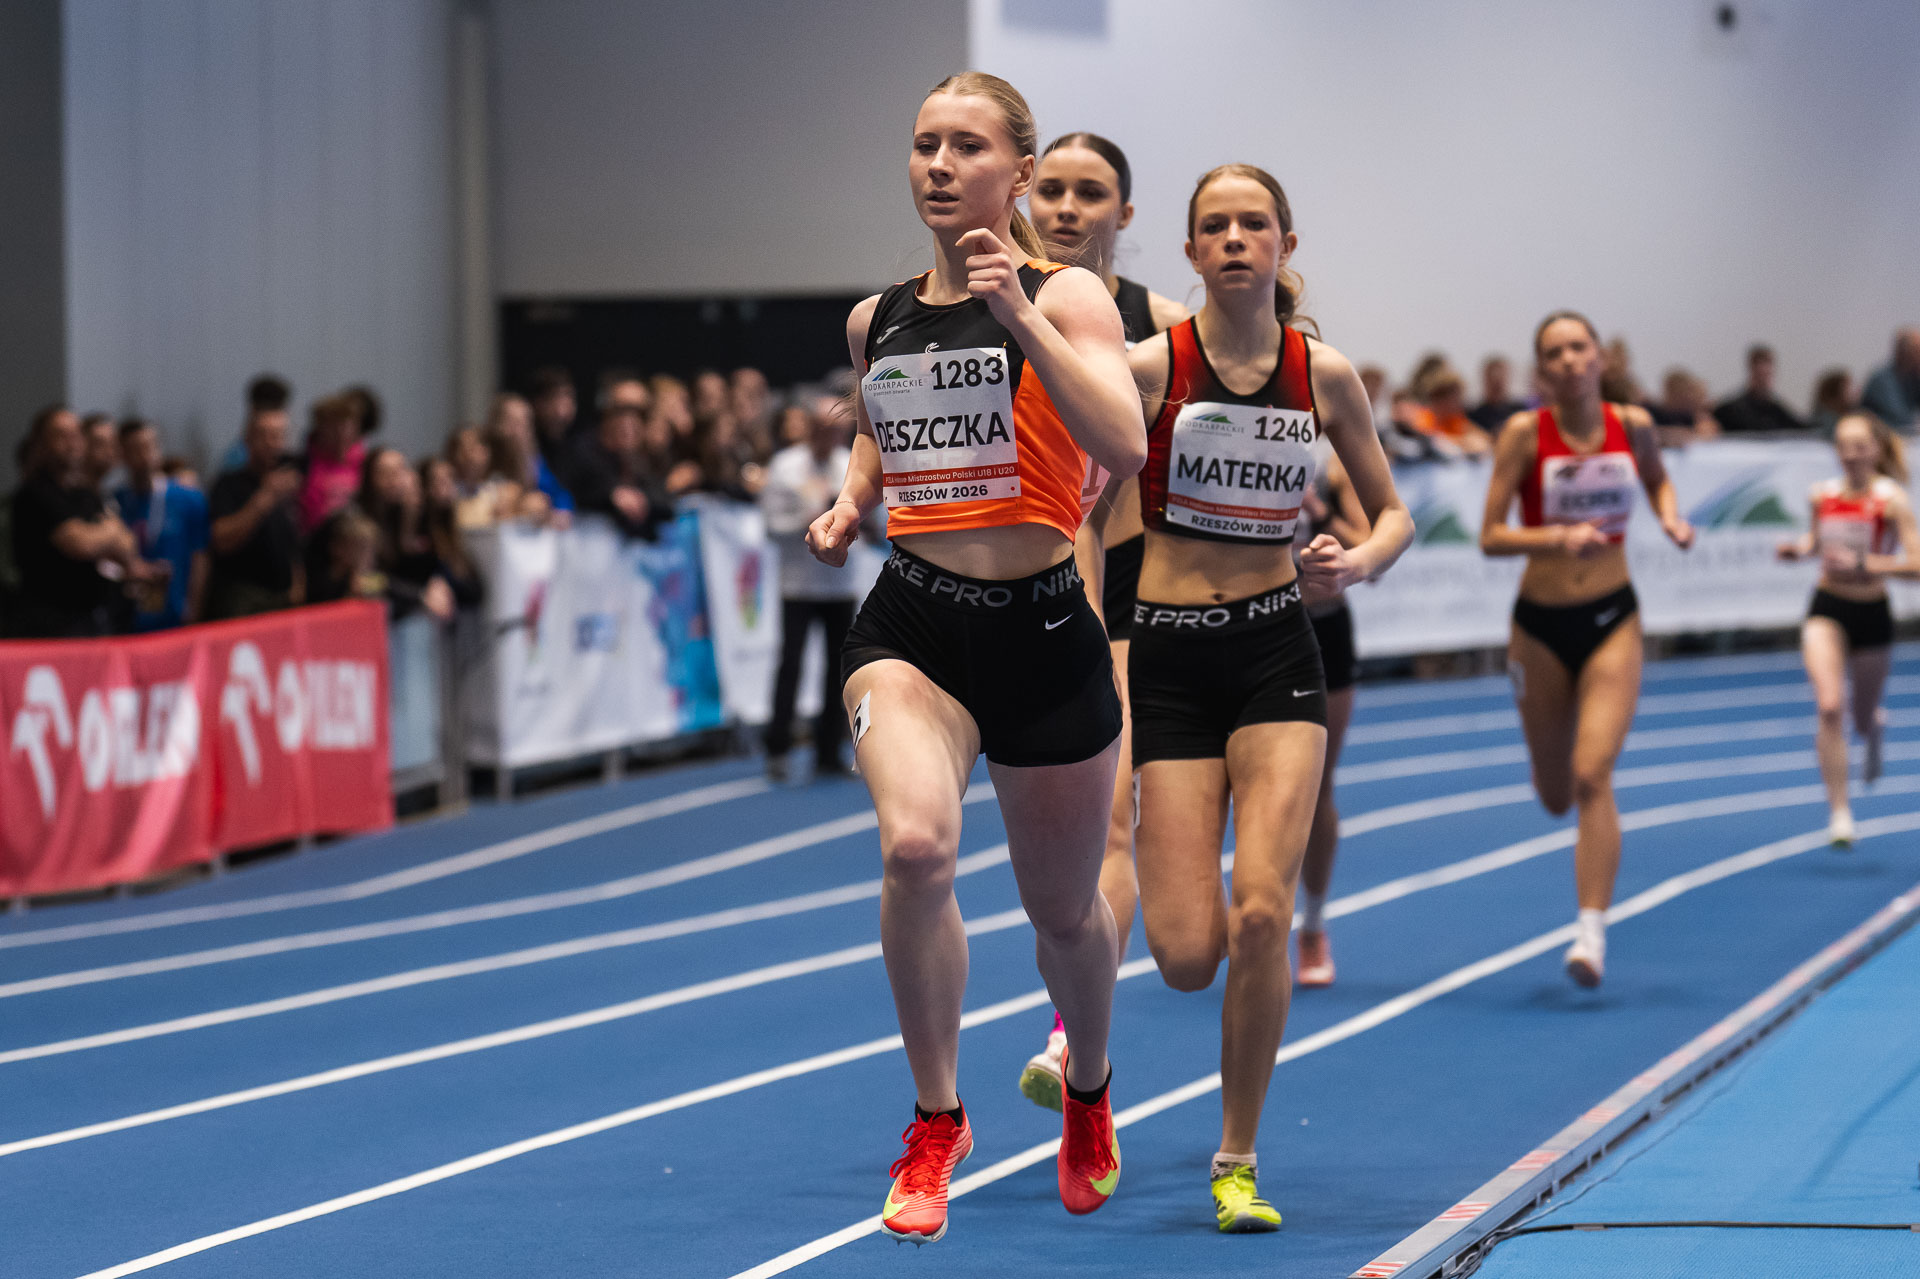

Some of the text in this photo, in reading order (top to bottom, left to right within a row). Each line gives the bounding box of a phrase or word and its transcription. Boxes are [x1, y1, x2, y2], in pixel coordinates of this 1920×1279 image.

[930, 356, 1004, 390] 1283
[864, 379, 923, 391] PODKARPACKIE
[875, 411, 1011, 453] DESZCZKA
[1180, 419, 1245, 434] PODKARPACKIE
[1254, 416, 1313, 443] 1246
[907, 473, 951, 483] Mistrzostwa
[952, 470, 976, 479] Polski
[977, 468, 992, 477] U18
[998, 466, 1015, 475] U20
[1177, 453, 1307, 492] MATERKA
[898, 485, 988, 503] RZESZÓW 2026
[1191, 514, 1283, 535] RZESZÓW 2026
[930, 575, 1013, 608] PRO
[1151, 608, 1231, 628] PRO
